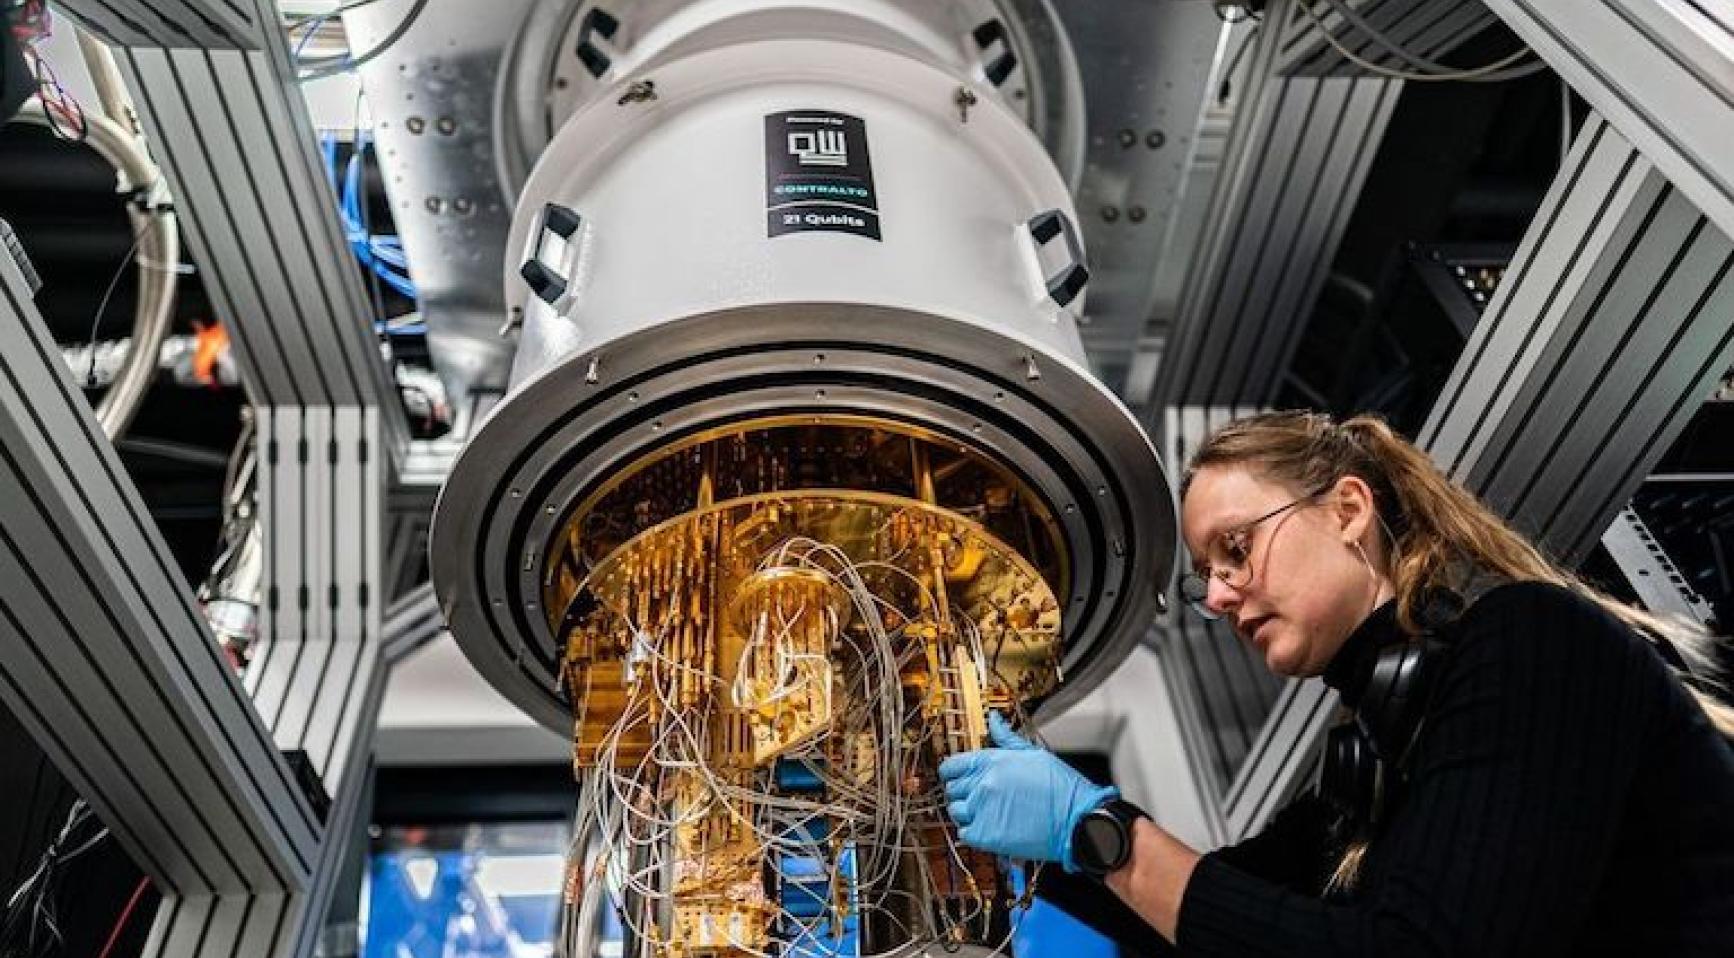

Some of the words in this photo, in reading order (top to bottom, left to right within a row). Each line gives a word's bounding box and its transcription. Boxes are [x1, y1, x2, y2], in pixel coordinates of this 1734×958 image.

[774, 184, 868, 198] CONTRALTO
[783, 214, 801, 225] 21
[805, 214, 866, 227] Qubits
